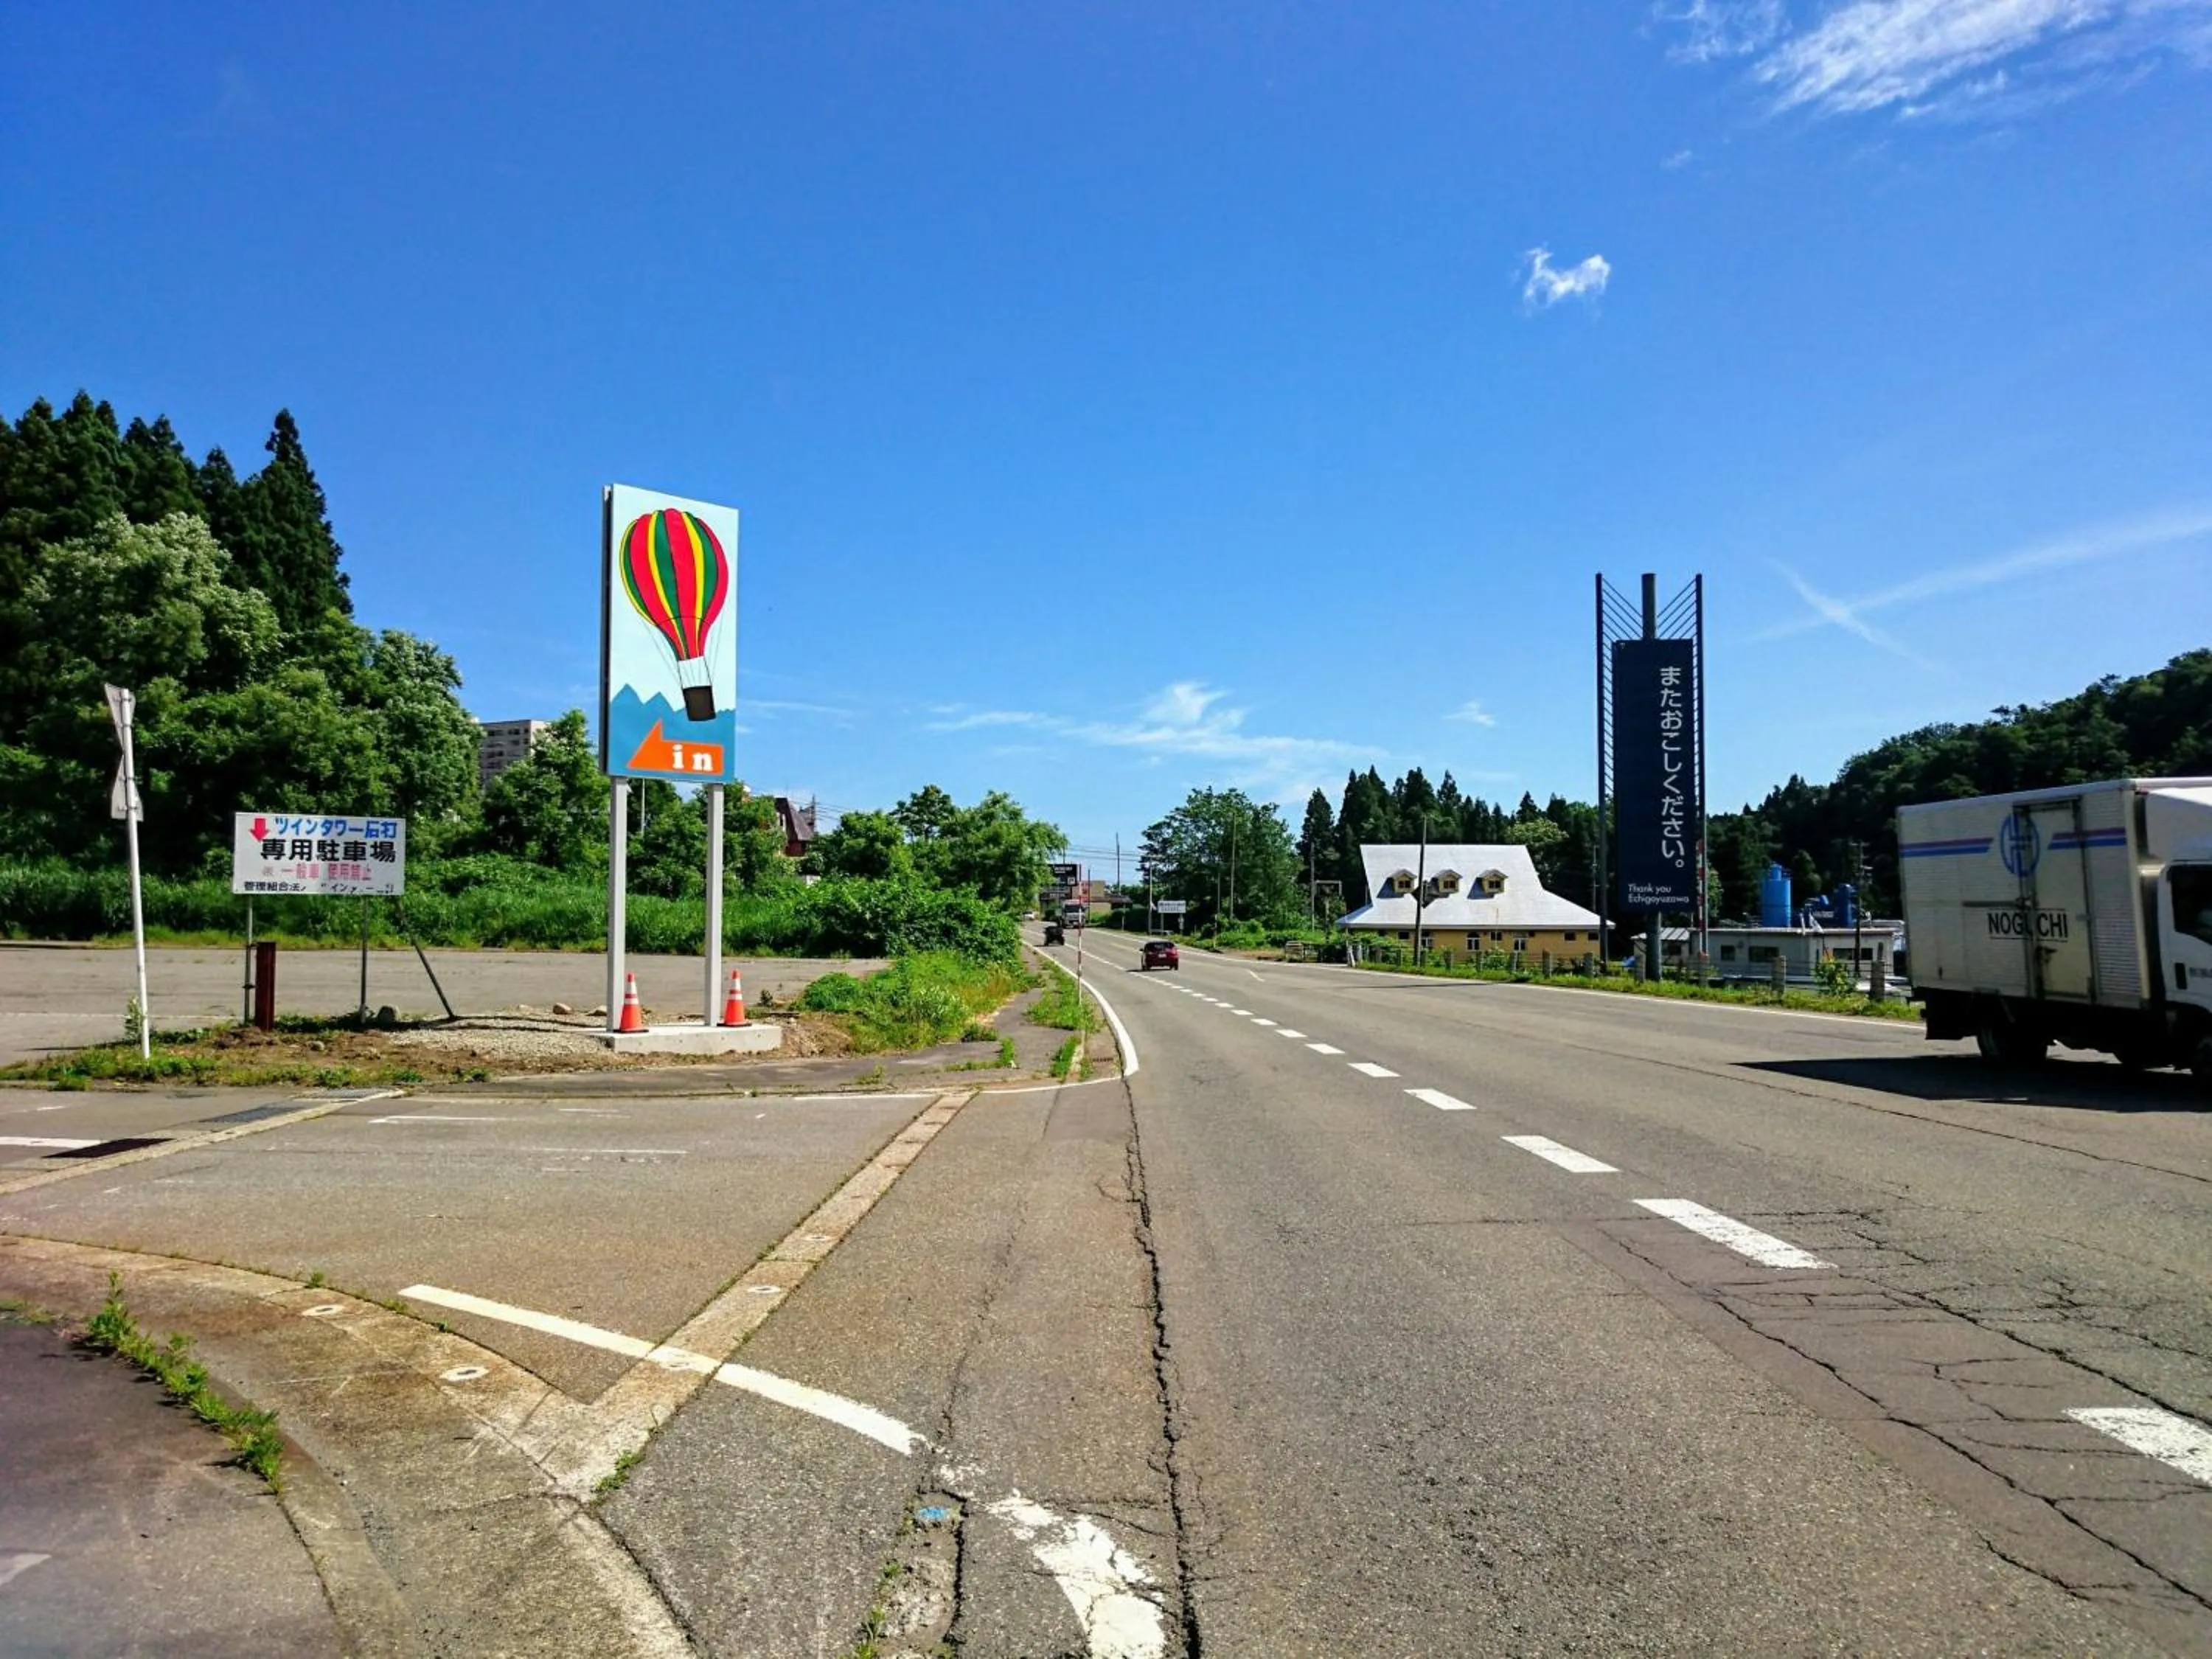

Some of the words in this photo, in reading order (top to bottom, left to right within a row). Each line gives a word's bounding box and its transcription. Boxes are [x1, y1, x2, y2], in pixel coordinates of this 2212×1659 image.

[672, 744, 713, 771] in
[1659, 667, 1685, 868] またおこしください。
[275, 817, 397, 838] ツインタワー石打
[260, 838, 396, 863] 専用駐車場
[1628, 883, 1653, 893] Thank
[1655, 886, 1672, 895] you
